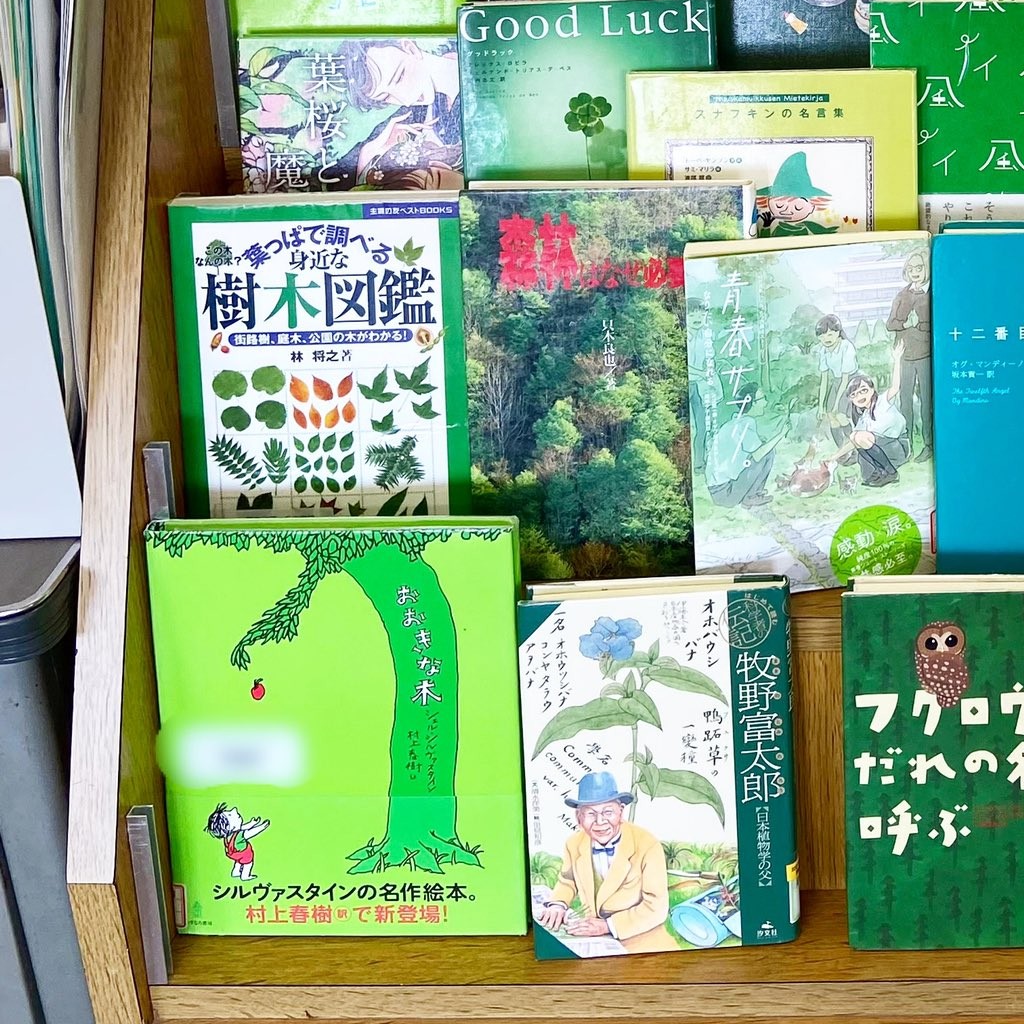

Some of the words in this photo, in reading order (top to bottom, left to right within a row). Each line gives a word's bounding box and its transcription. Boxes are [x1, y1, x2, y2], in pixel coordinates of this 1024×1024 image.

[459, 5, 582, 43] Good
[600, 0, 710, 37] Luck
[695, 108, 844, 120] スナフキンの名言集
[242, 224, 393, 269] 葉っぱで調べる
[290, 249, 349, 271] 身近な
[201, 267, 437, 330] 樹木図鑑
[396, 584, 443, 707] おおきな木
[736, 650, 781, 804] 牧野富太郎
[859, 799, 972, 856] 呼ぶ
[212, 882, 477, 903] シルヴァスタインの名作絵本。
